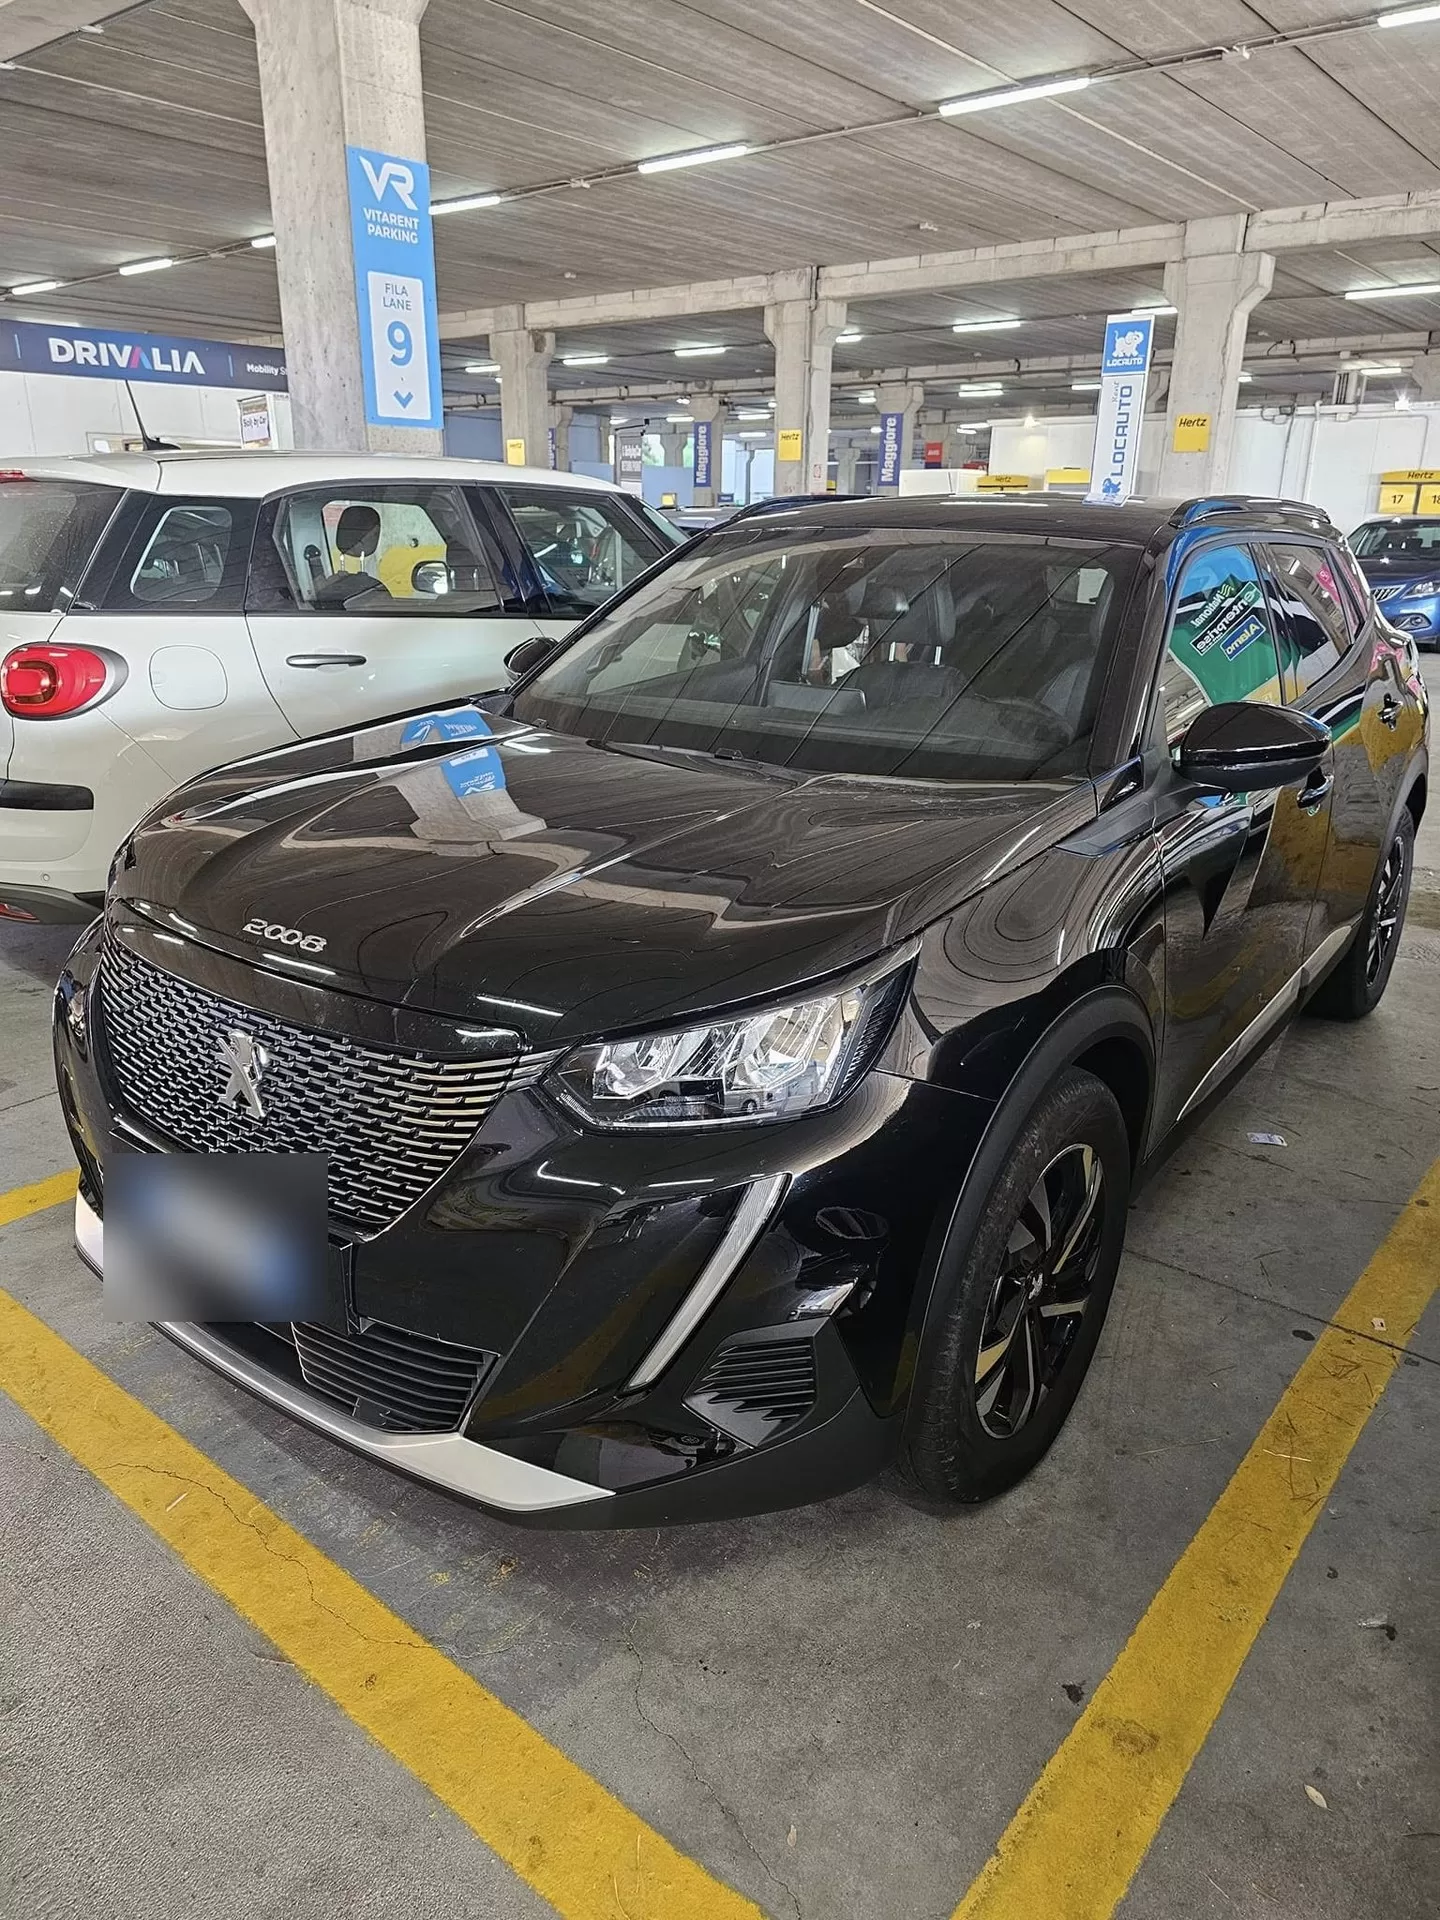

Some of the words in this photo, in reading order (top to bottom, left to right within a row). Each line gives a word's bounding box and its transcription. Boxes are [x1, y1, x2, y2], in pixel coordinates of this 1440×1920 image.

[359, 155, 419, 211] VR
[362, 206, 420, 230] VITARENT
[367, 222, 419, 244] PARKING
[384, 282, 409, 297] FILA
[382, 296, 412, 311] LANE
[387, 320, 413, 366] 9
[48, 337, 206, 375] DRIVALIA
[1106, 357, 1144, 367] LOCAUTO
[246, 362, 279, 376] Mobility
[1110, 385, 1133, 477] LOCAUTO
[1178, 417, 1207, 428] Hertz
[695, 425, 708, 484] Maggiore
[882, 416, 898, 483] Maggiore
[1407, 471, 1434, 480] Hertz
[1391, 494, 1404, 504] 17
[242, 918, 327, 953] 2008
